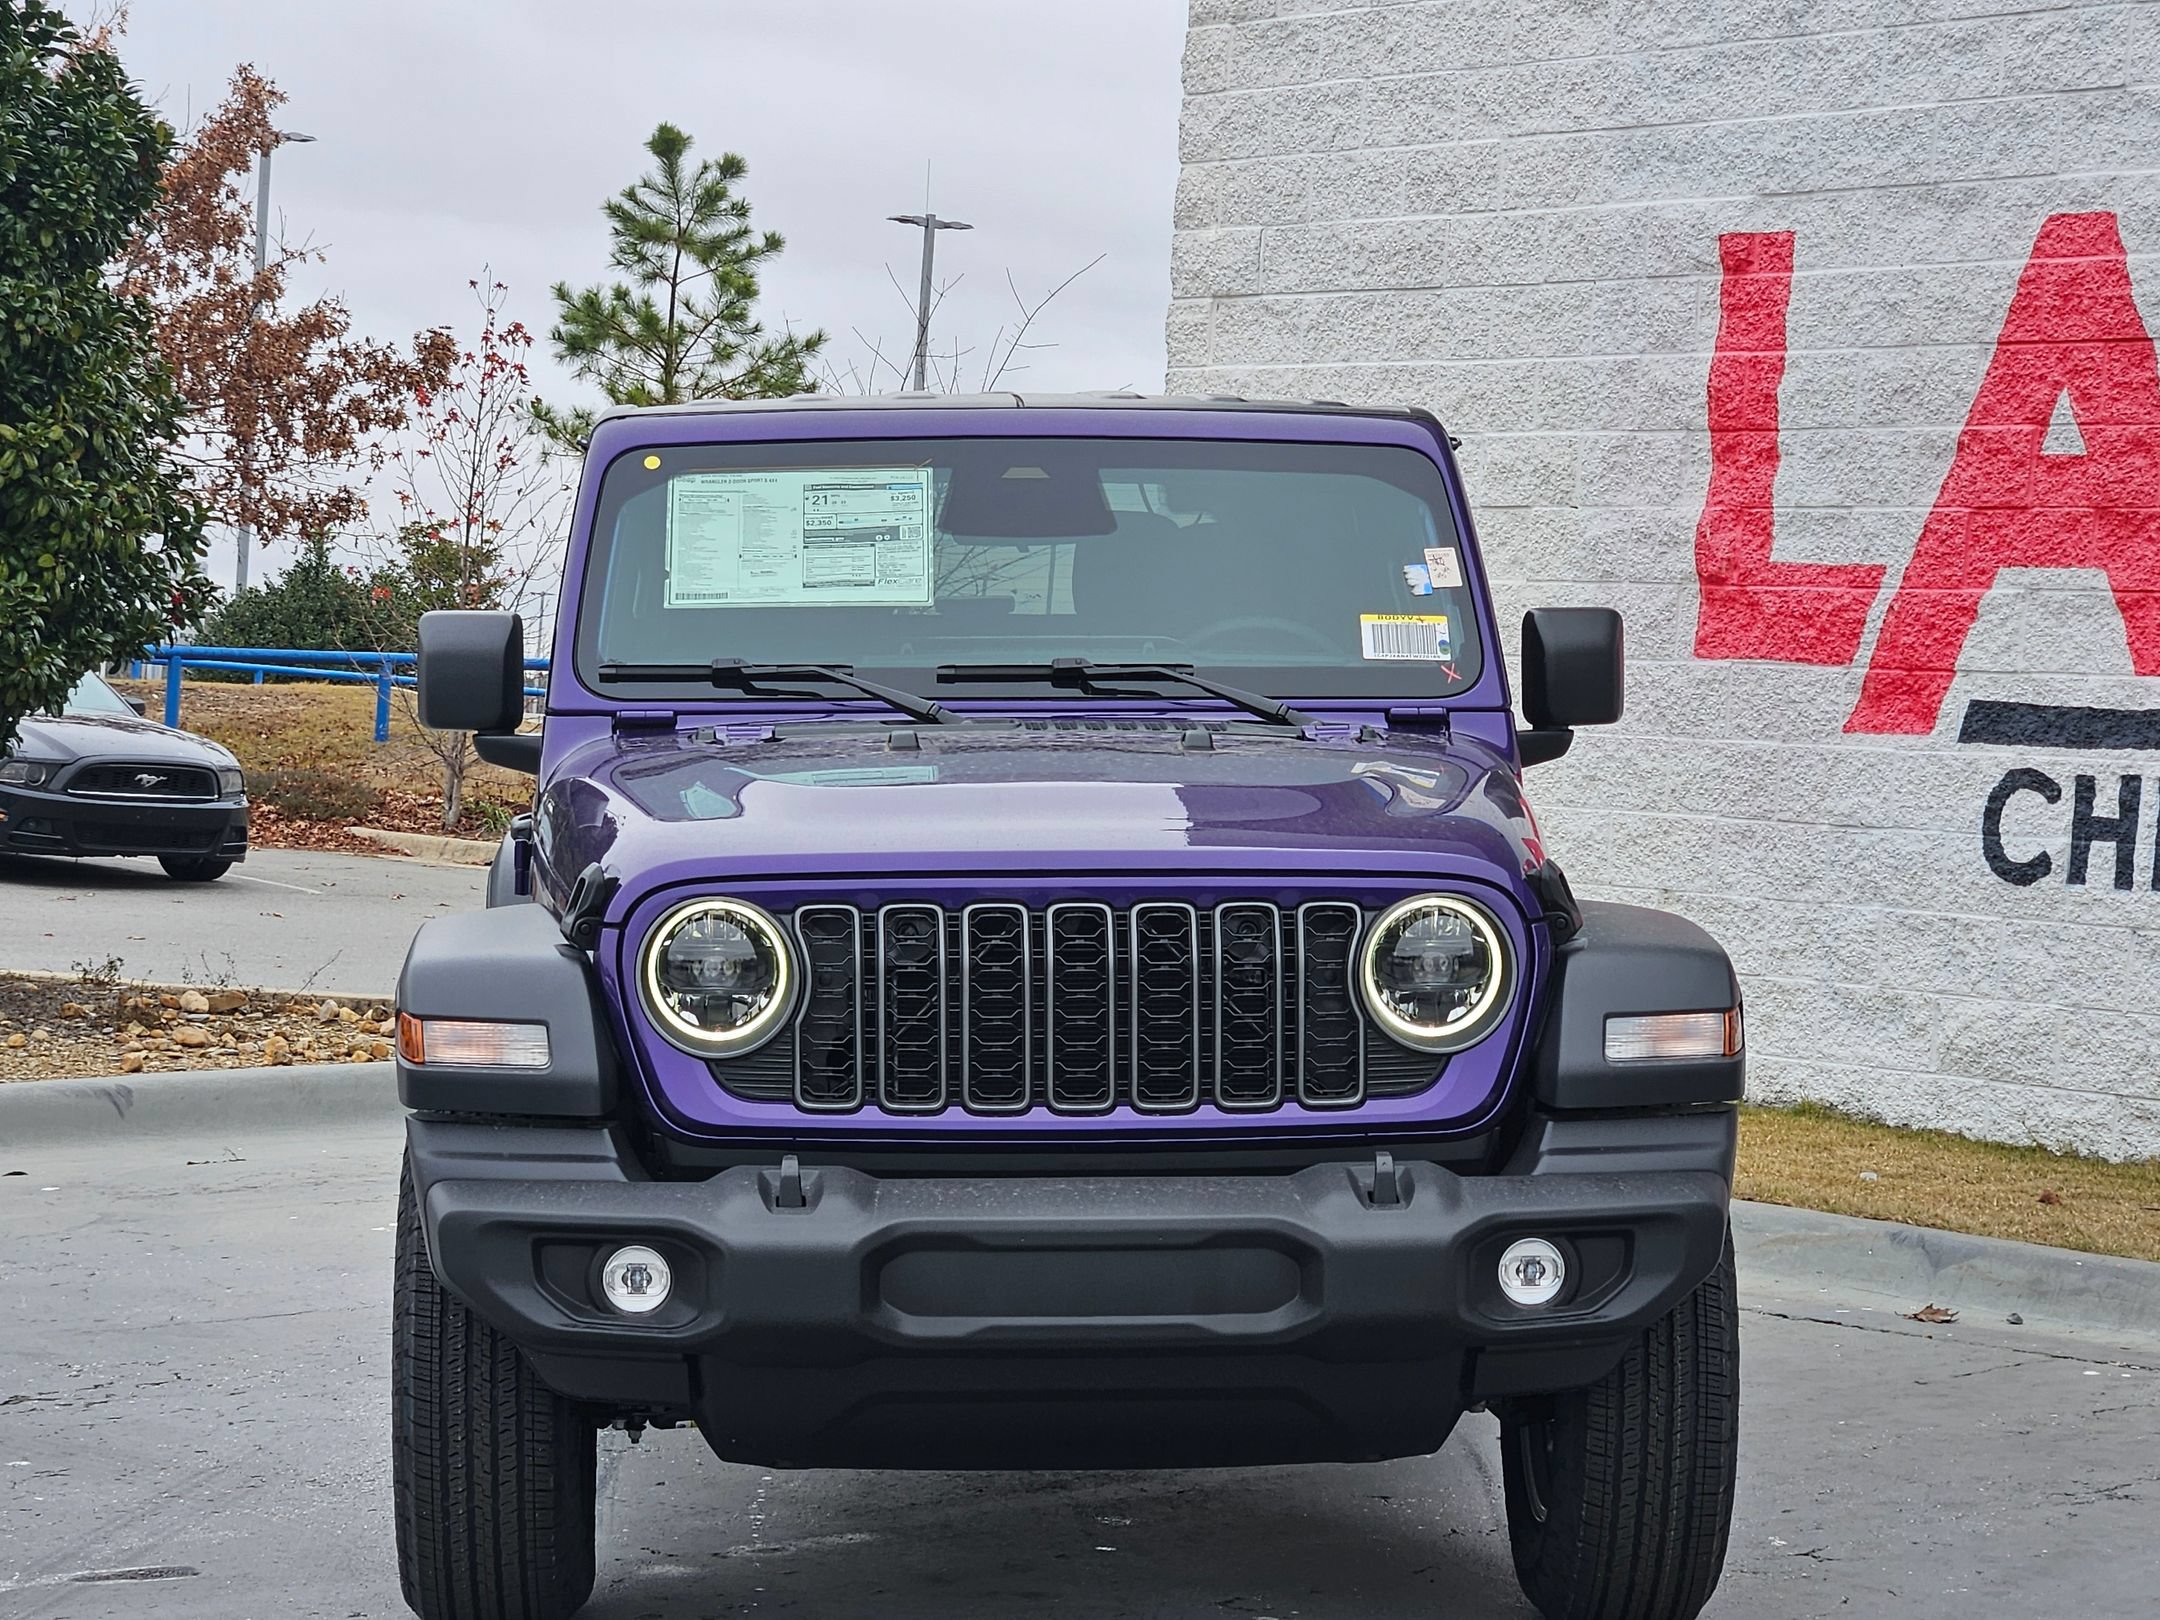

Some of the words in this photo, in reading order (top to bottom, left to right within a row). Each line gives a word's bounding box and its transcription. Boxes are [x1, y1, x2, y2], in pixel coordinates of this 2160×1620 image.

[812, 494, 828, 506] 21
[890, 494, 916, 502] $3,250
[1982, 767, 2160, 892] CH
